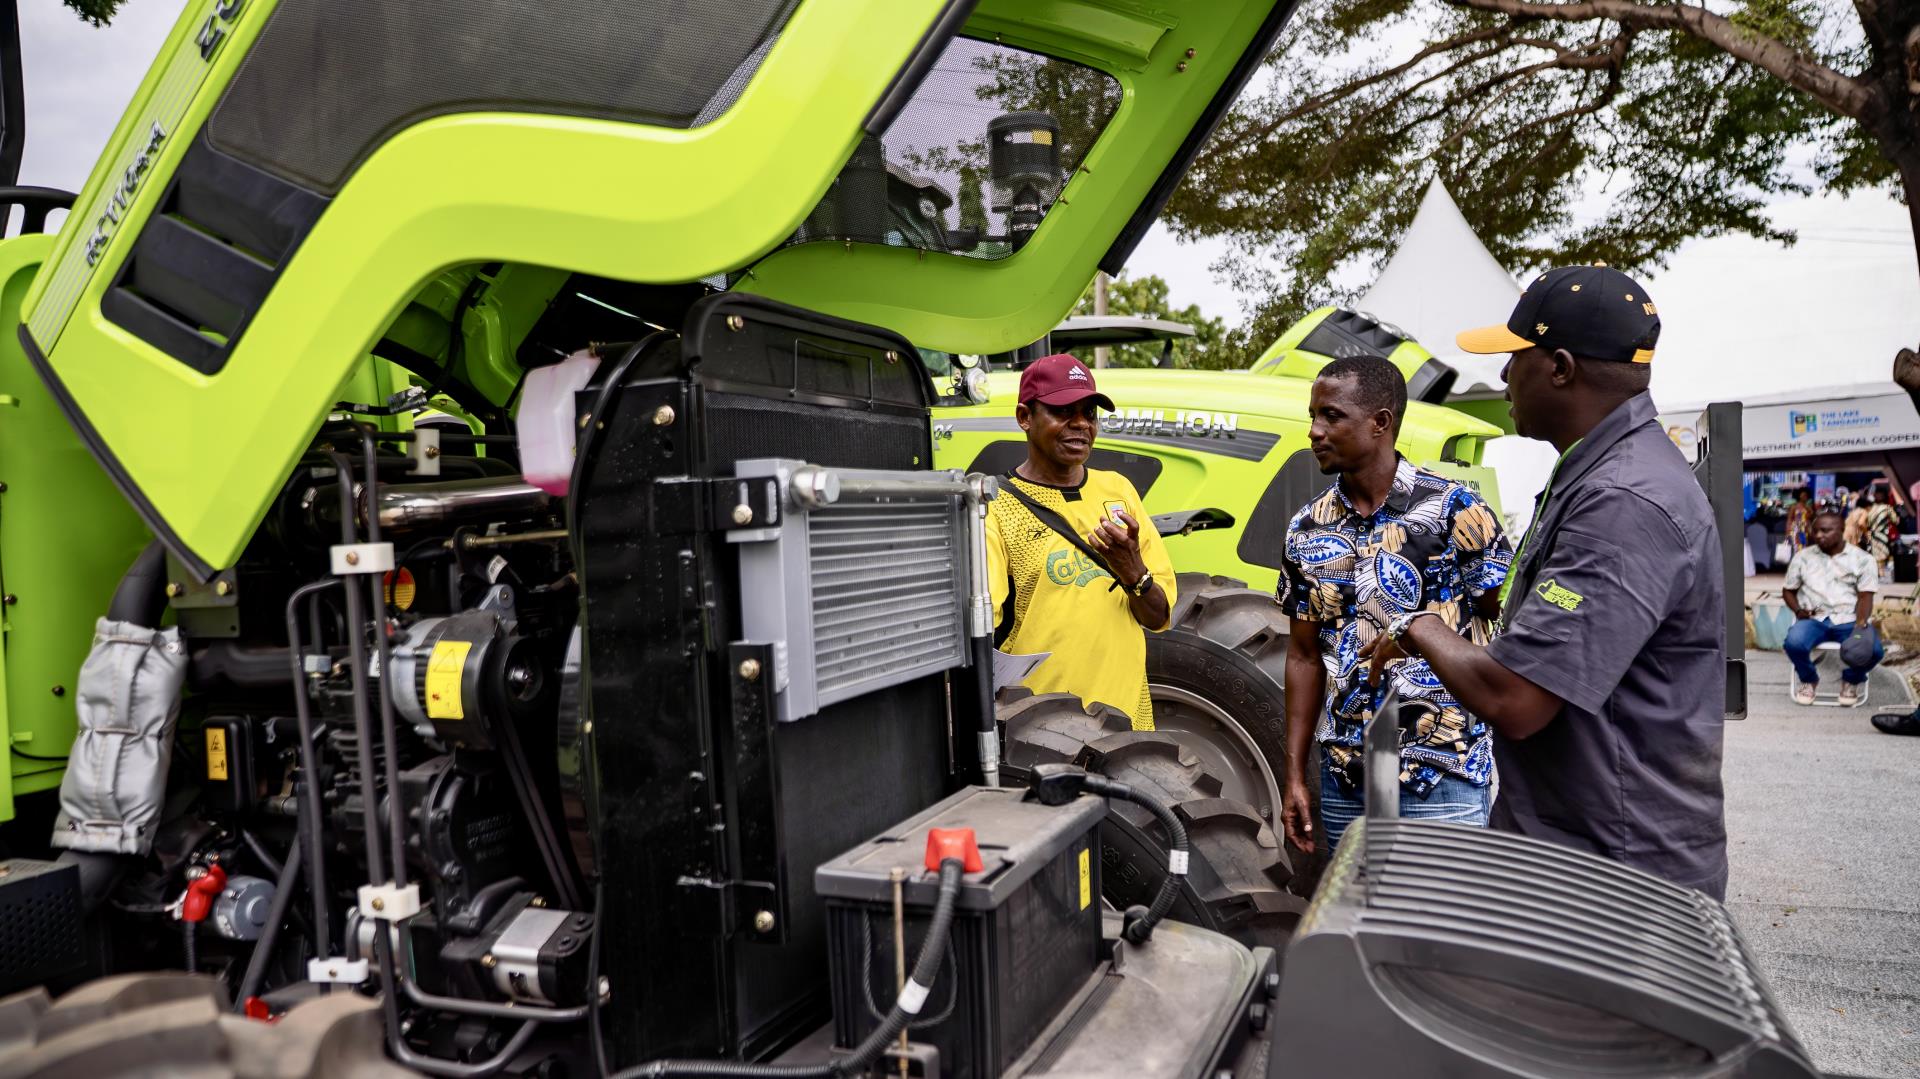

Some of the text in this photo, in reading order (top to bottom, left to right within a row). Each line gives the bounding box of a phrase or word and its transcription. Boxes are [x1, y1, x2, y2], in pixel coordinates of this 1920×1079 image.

[1097, 407, 1237, 439] OMLION
[1743, 441, 1801, 453] NVESTMENT
[1814, 437, 1868, 448] REGIONAL
